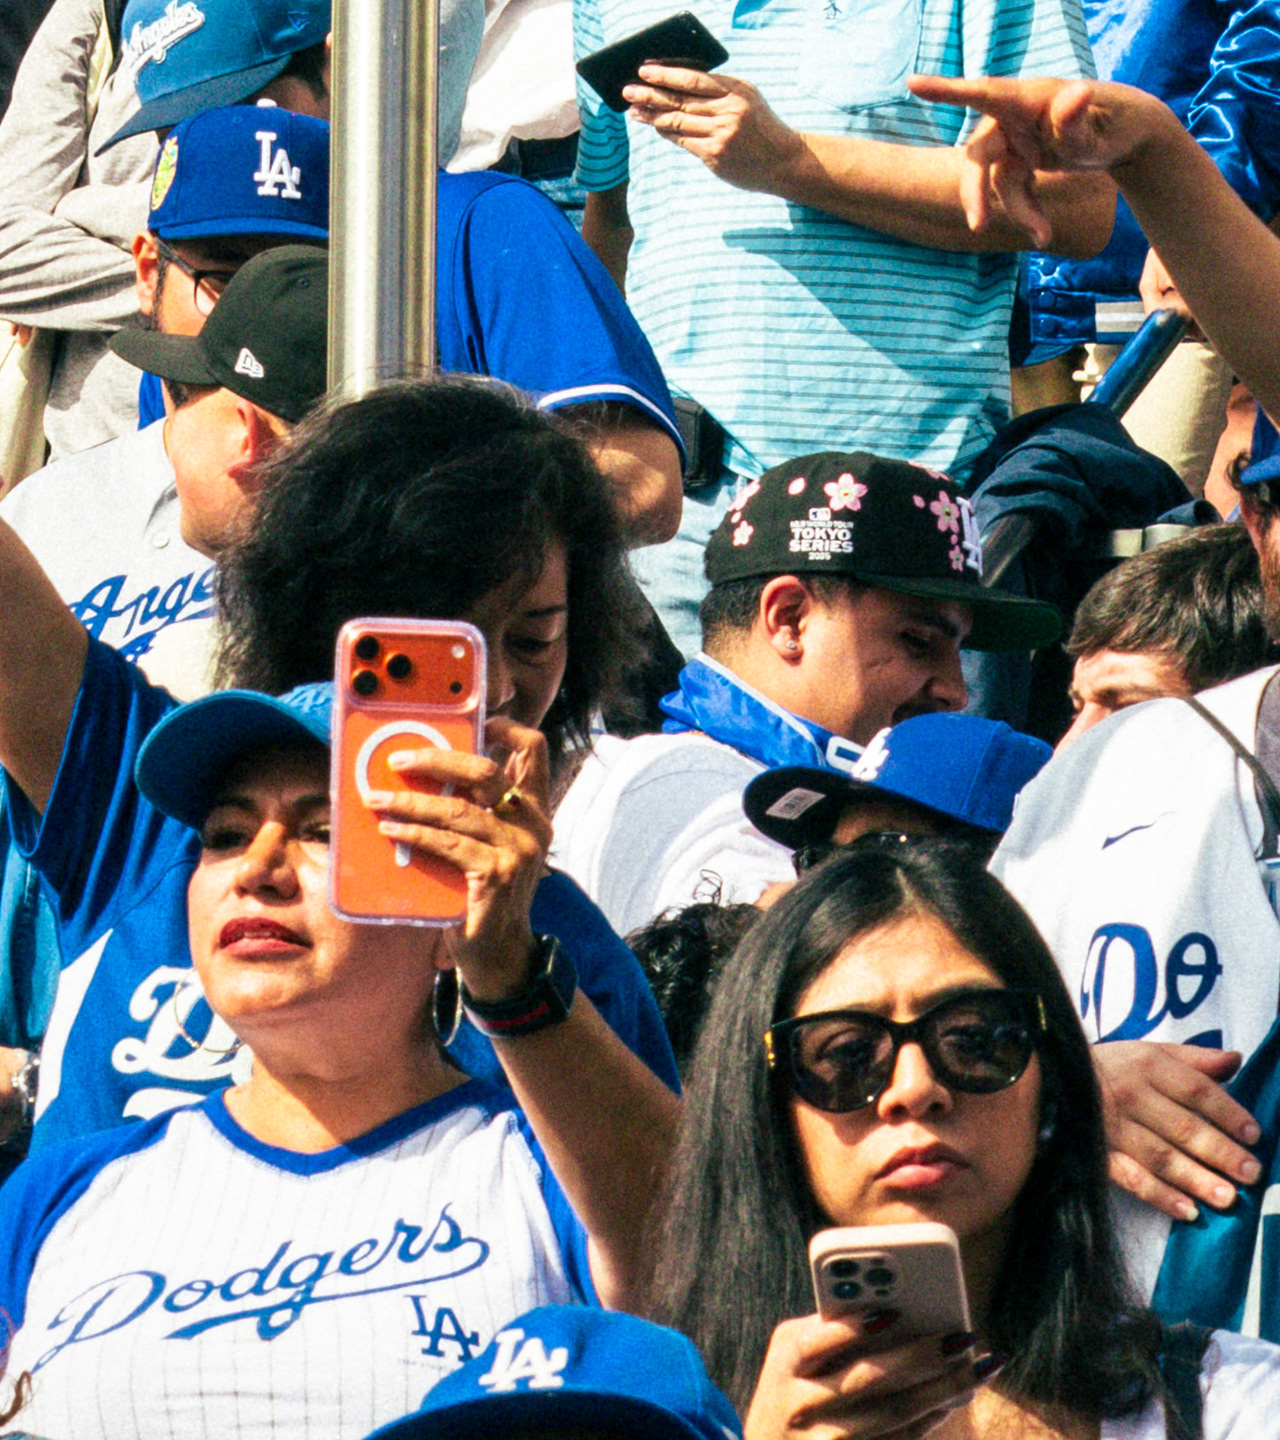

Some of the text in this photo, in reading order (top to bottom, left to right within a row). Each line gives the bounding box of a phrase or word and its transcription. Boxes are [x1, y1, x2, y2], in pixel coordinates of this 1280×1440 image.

[254, 131, 301, 199] LA
[789, 540, 854, 553] SERIES
[791, 528, 852, 540] TOKYO
[68, 563, 218, 666] Ange
[32, 1202, 490, 1375] Dodgers
[403, 1294, 481, 1363] LA
[478, 1327, 569, 1394] LA
